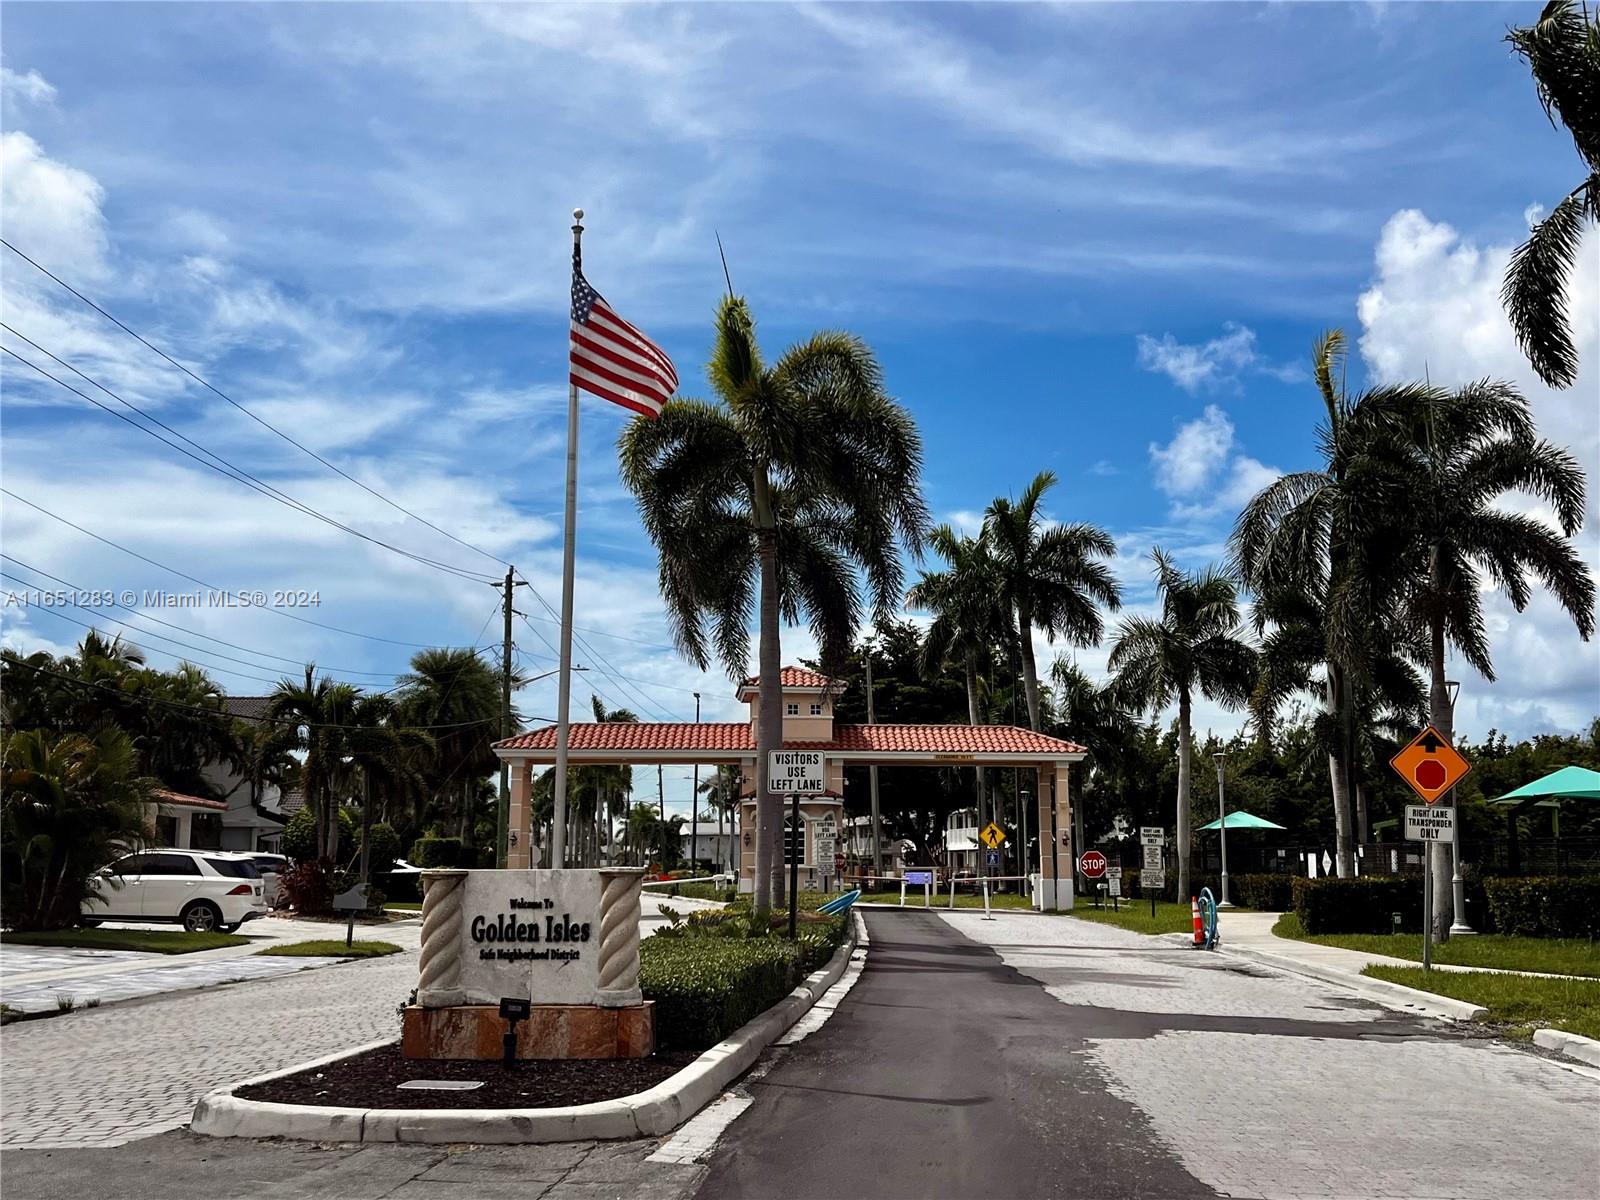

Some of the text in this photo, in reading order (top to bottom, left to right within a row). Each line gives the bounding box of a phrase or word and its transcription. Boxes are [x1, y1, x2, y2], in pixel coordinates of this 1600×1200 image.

[775, 754, 819, 765] VISITORS
[787, 767, 806, 777] USE
[771, 780, 822, 790] LEFT LANE
[1412, 809, 1448, 819] RIGHT LANE
[1408, 818, 1452, 828] TRANSPONDER
[1420, 828, 1440, 838] ONLY
[1082, 860, 1104, 870] STOP
[510, 898, 554, 909] Welcome To
[471, 914, 590, 942] Golden Isles
[480, 949, 580, 963] Safe Neighborhood District
